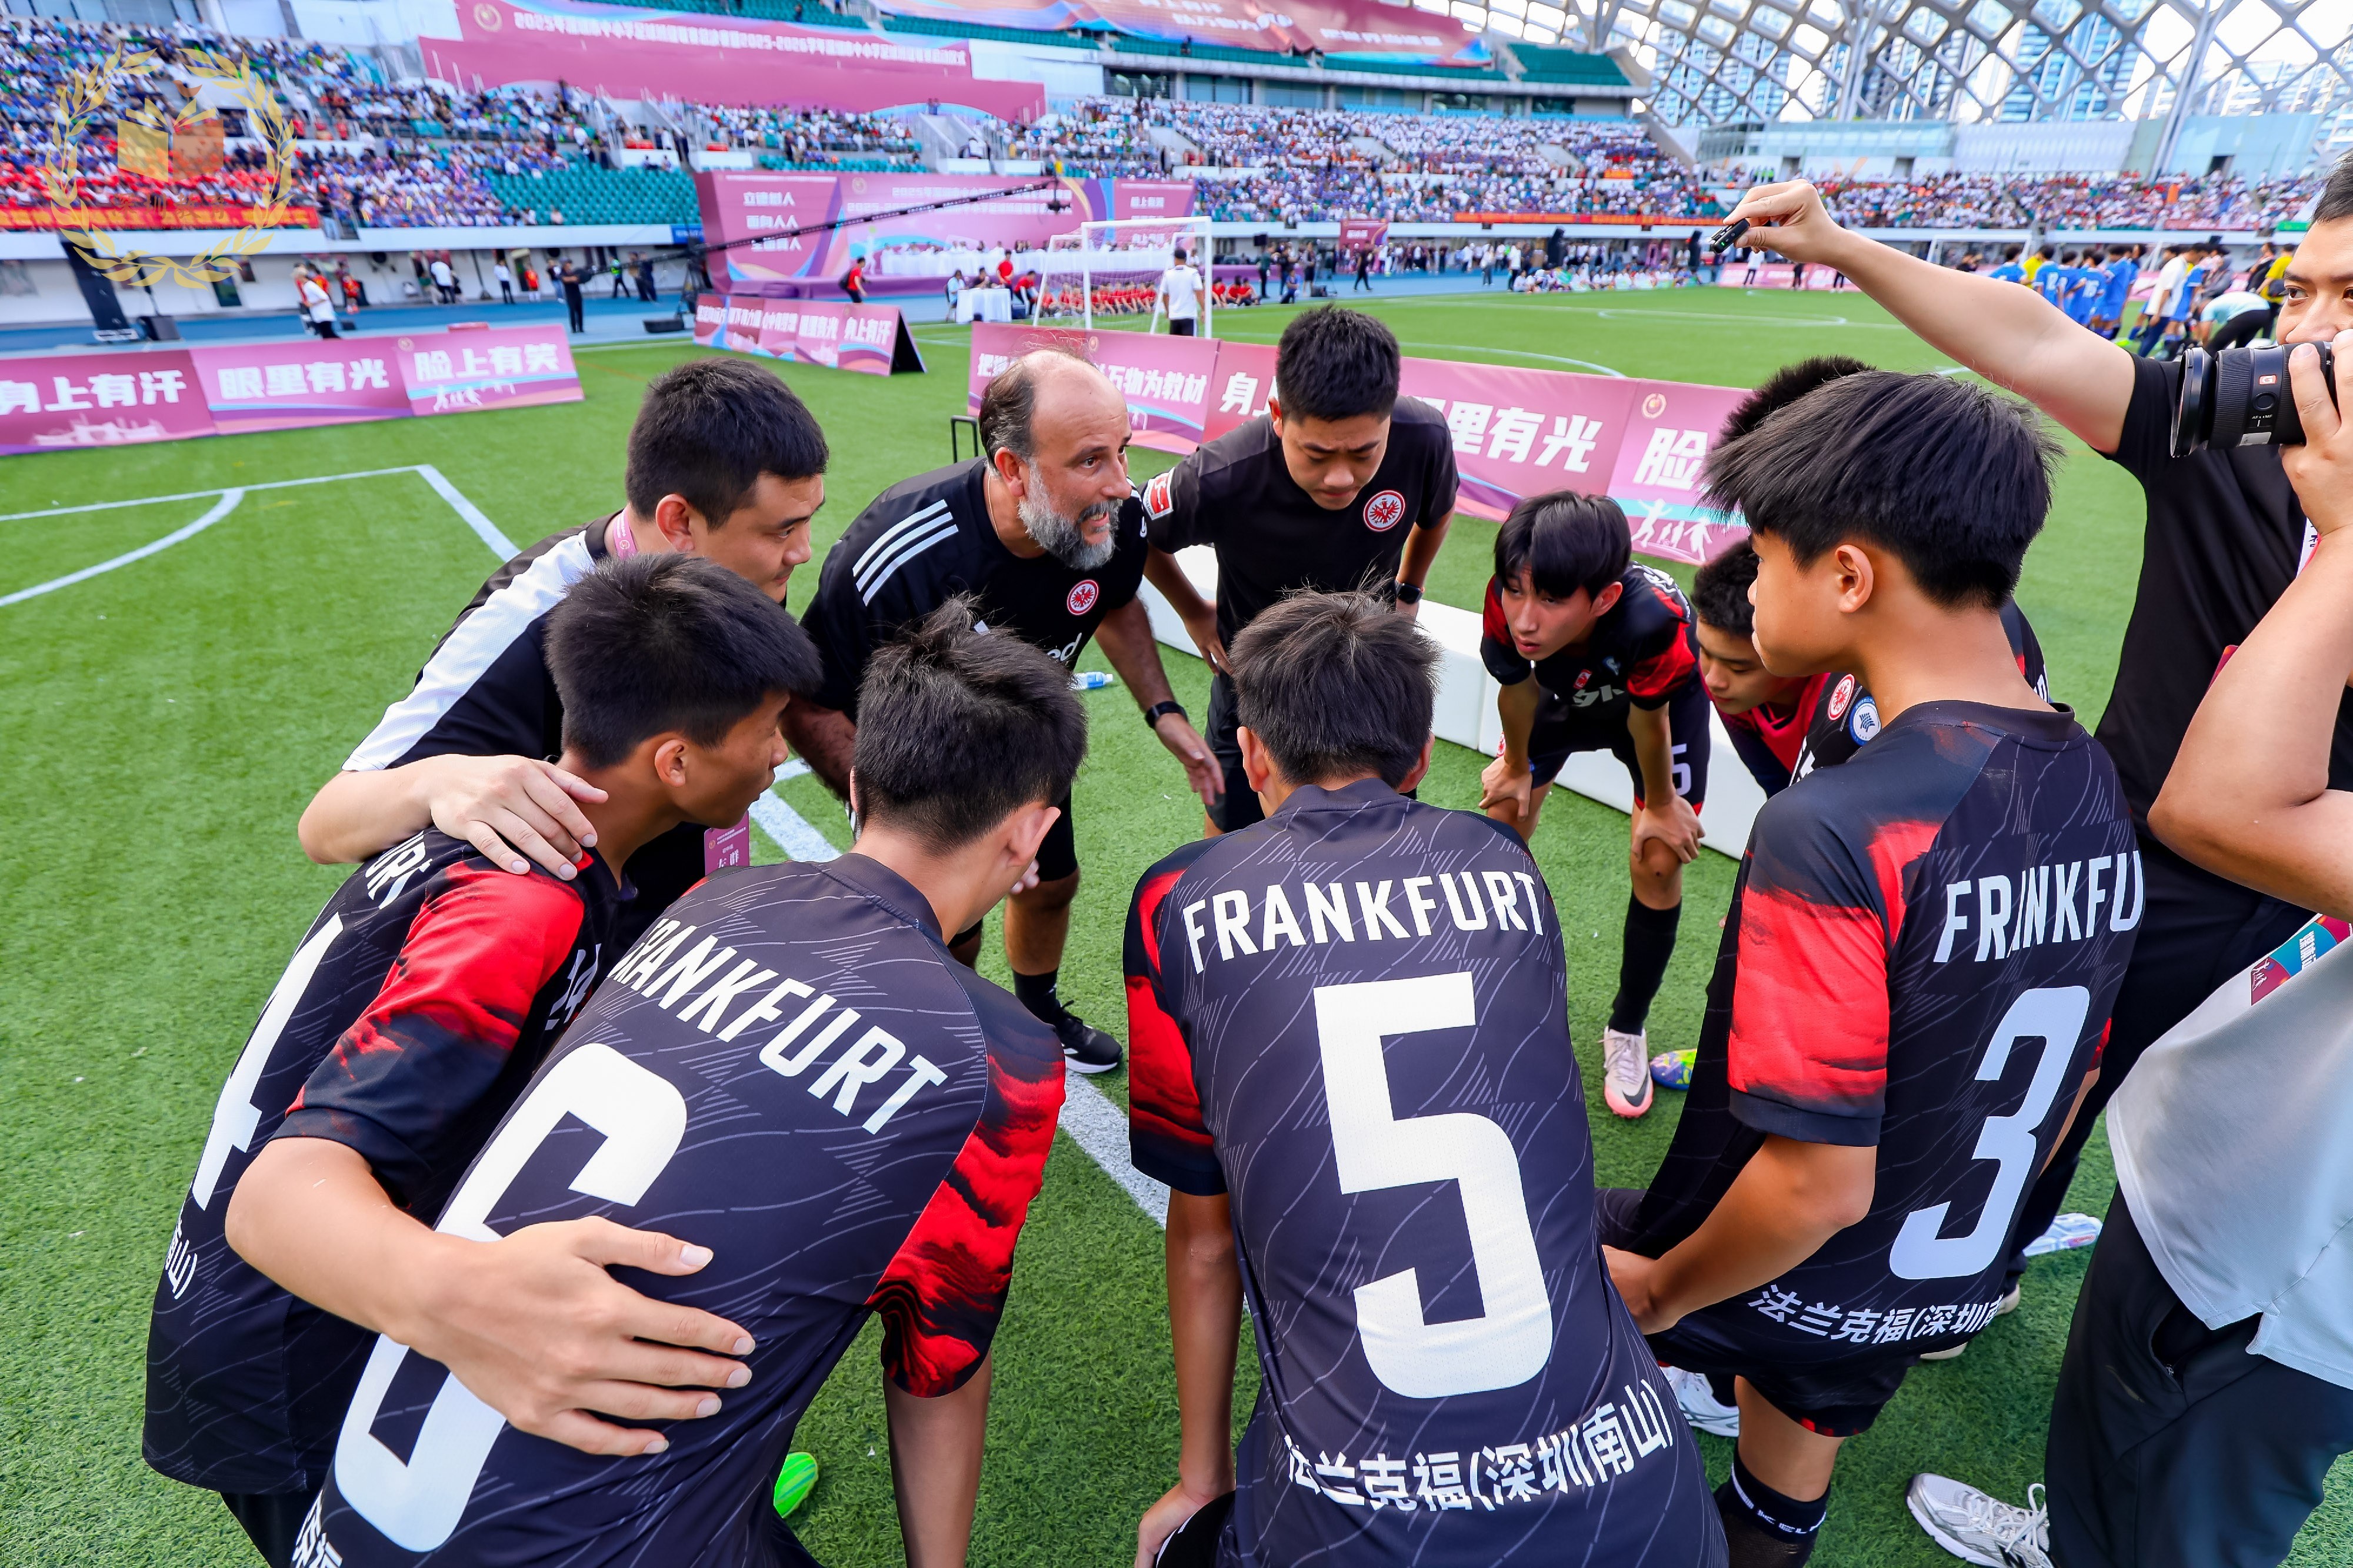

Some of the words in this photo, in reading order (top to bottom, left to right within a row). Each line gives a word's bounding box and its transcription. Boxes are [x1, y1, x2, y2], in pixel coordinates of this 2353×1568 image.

[218, 358, 390, 400] 眼里有光
[414, 343, 560, 382] 脸上有笑
[1633, 427, 1711, 491] 脸
[1182, 871, 1544, 974] FRANKFURT
[1889, 985, 2090, 1280] 3
[1314, 971, 1553, 1399] 5
[335, 1043, 687, 1552] 6
